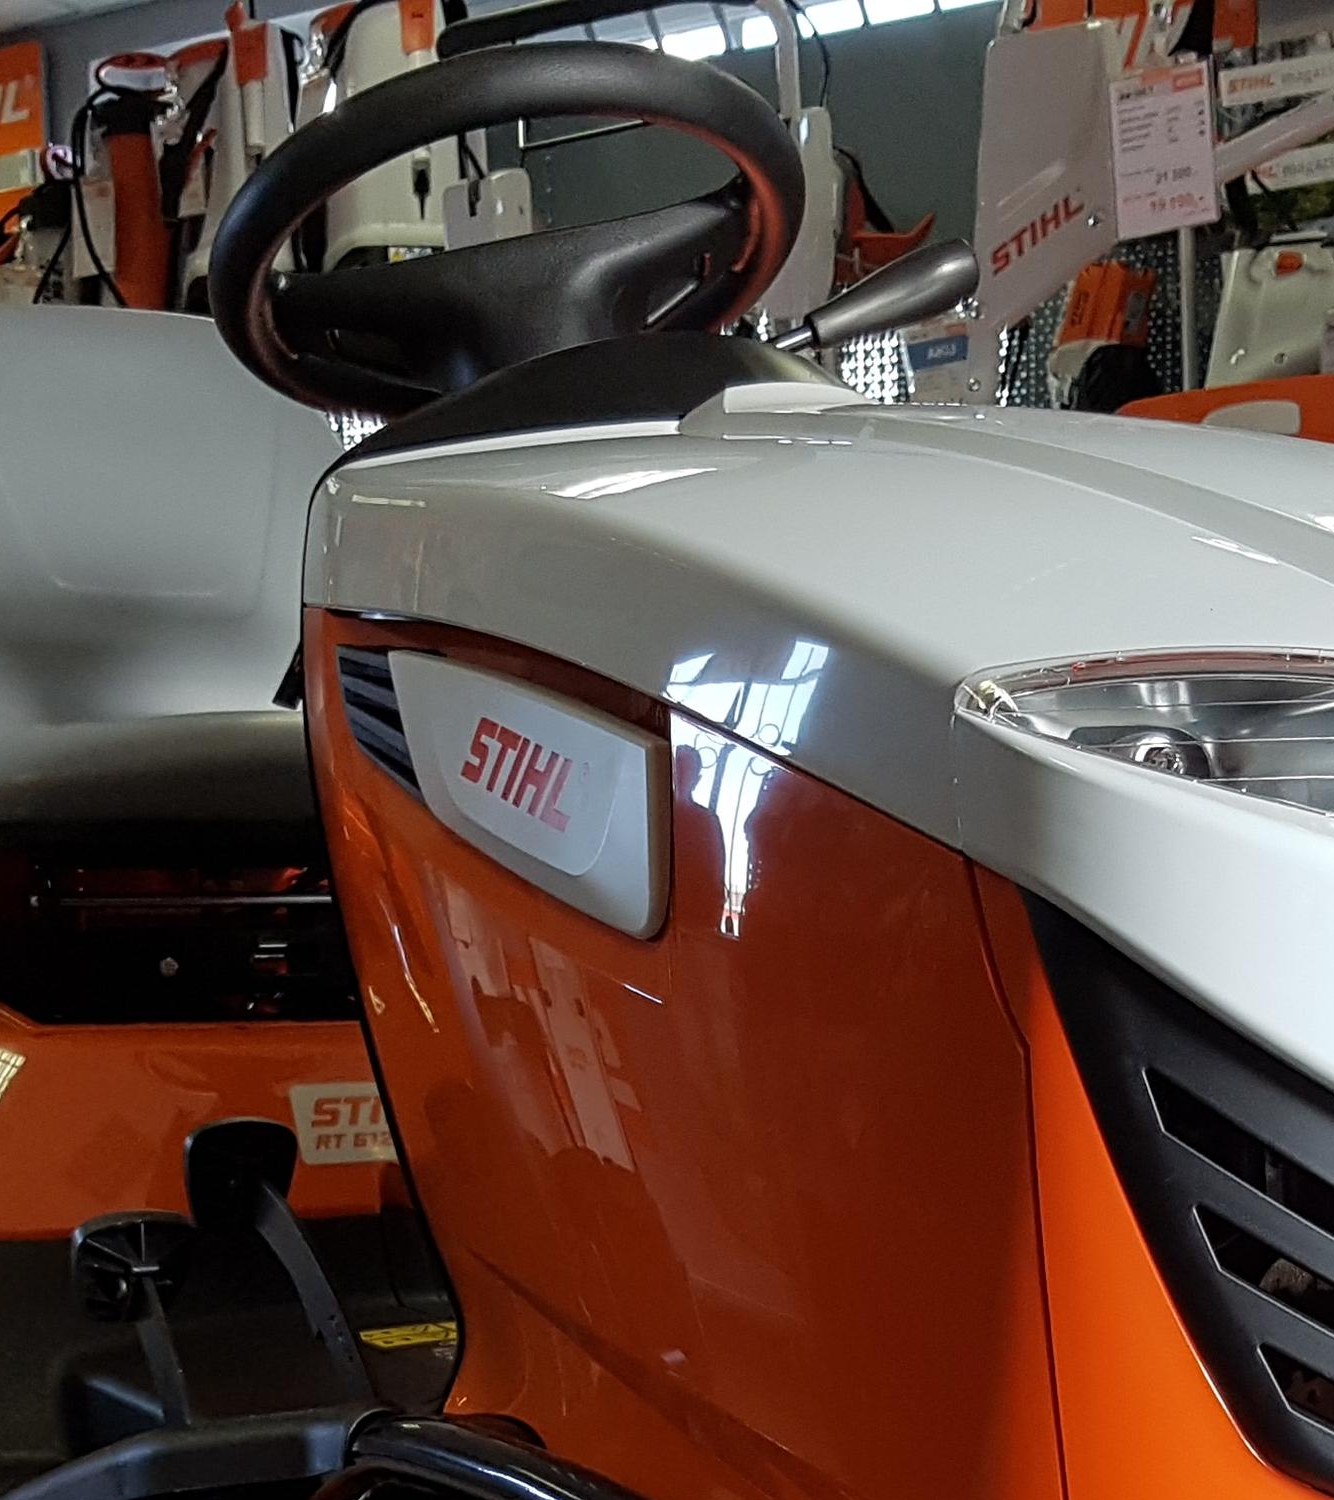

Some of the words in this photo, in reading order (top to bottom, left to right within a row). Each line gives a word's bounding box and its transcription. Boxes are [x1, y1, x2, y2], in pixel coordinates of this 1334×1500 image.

[992, 194, 1084, 276] STIHL
[460, 716, 573, 833] STIHL
[311, 1096, 382, 1128] STI
[316, 1133, 347, 1150] RT
